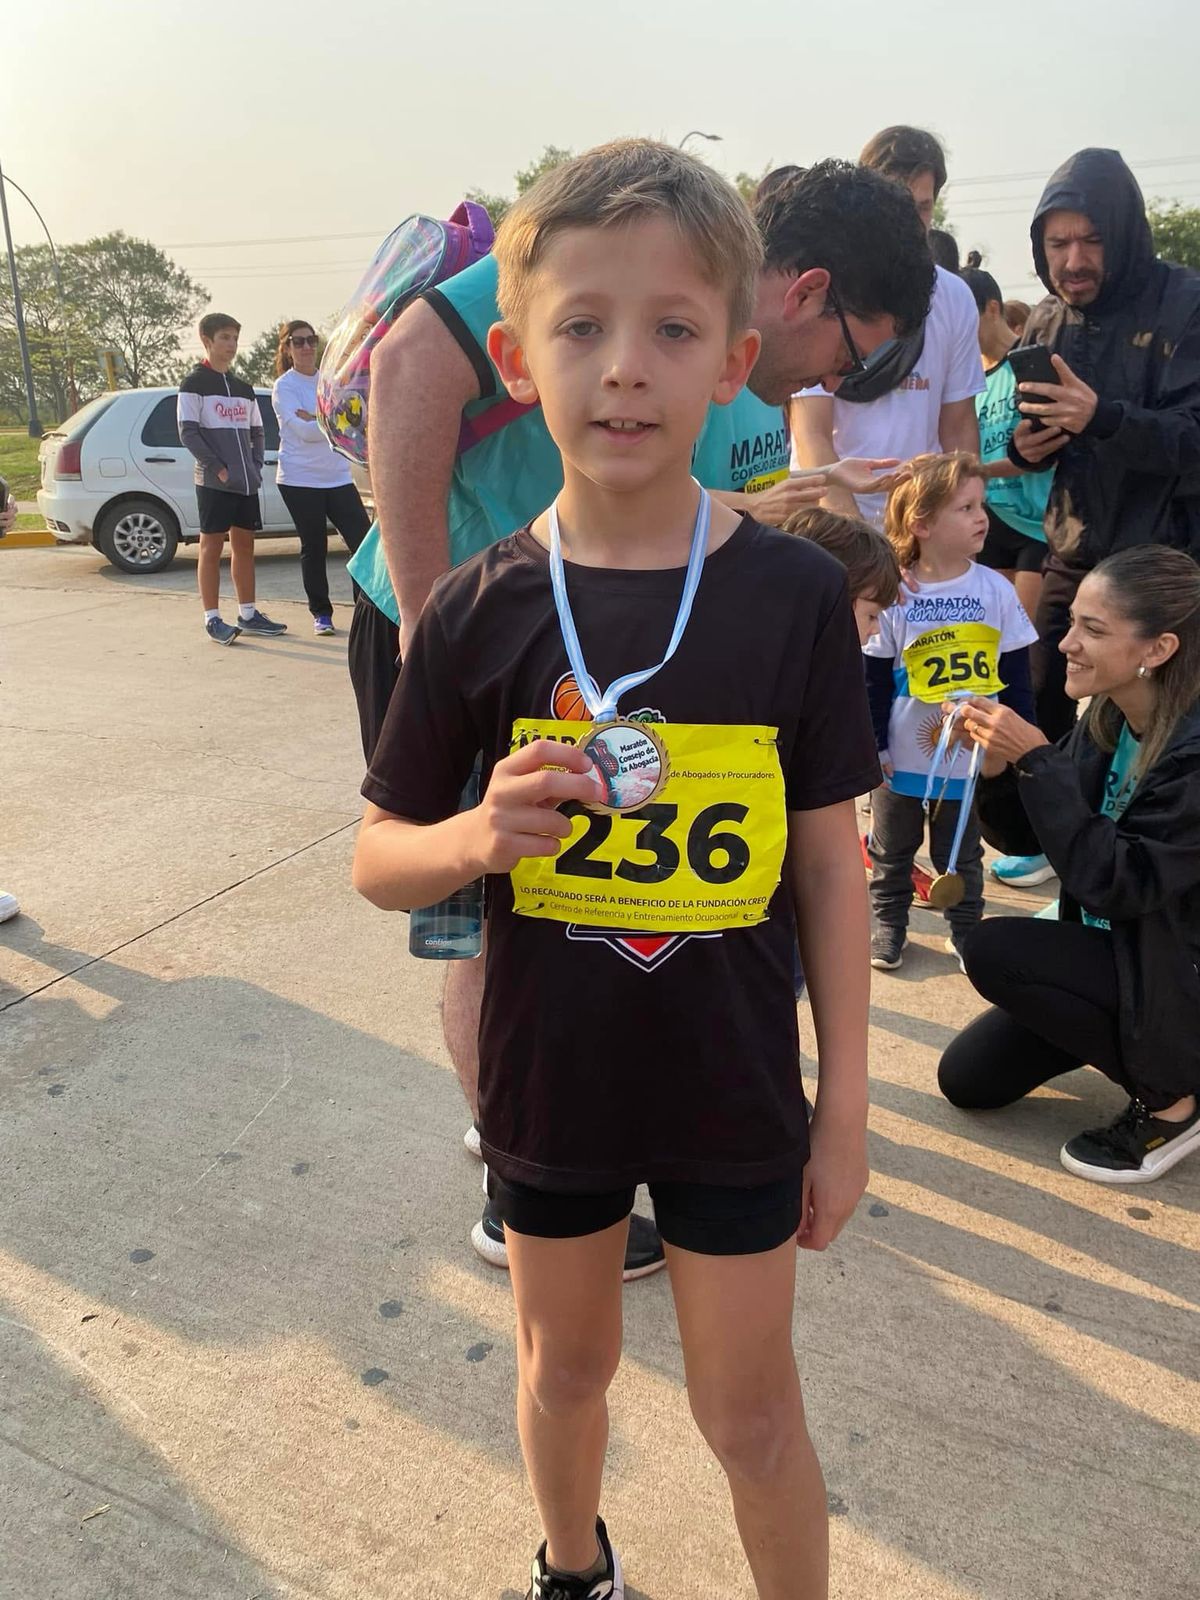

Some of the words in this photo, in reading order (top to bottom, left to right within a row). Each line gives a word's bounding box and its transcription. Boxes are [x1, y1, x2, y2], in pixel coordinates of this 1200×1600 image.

[914, 595, 980, 609] MARATÓN
[906, 605, 986, 623] convivencia
[923, 651, 990, 688] 256
[620, 739, 648, 753] Maratón
[619, 750, 646, 764] Consejo
[646, 747, 655, 755] de
[620, 766, 629, 774] la
[628, 756, 659, 771] Abogacía
[670, 770, 681, 779] de
[682, 771, 720, 780] Abogados
[721, 772, 727, 780] y
[727, 771, 775, 780] Procuradores
[555, 799, 751, 885] 236
[520, 886, 531, 895] LO
[531, 887, 583, 902] RECAUDADO
[584, 893, 608, 904] SERÁ
[609, 896, 617, 905] A
[618, 896, 667, 908] BENEFICIO
[668, 900, 681, 908] DE
[682, 899, 695, 908] LA
[696, 897, 747, 908] FUNDACIÓN
[747, 895, 768, 906] CREO
[549, 901, 573, 913] Centro
[573, 904, 583, 914] de
[584, 908, 625, 919] Referencia
[626, 911, 632, 921] y
[634, 911, 694, 922] Entrenamiento
[694, 911, 740, 922] Ocupacional
